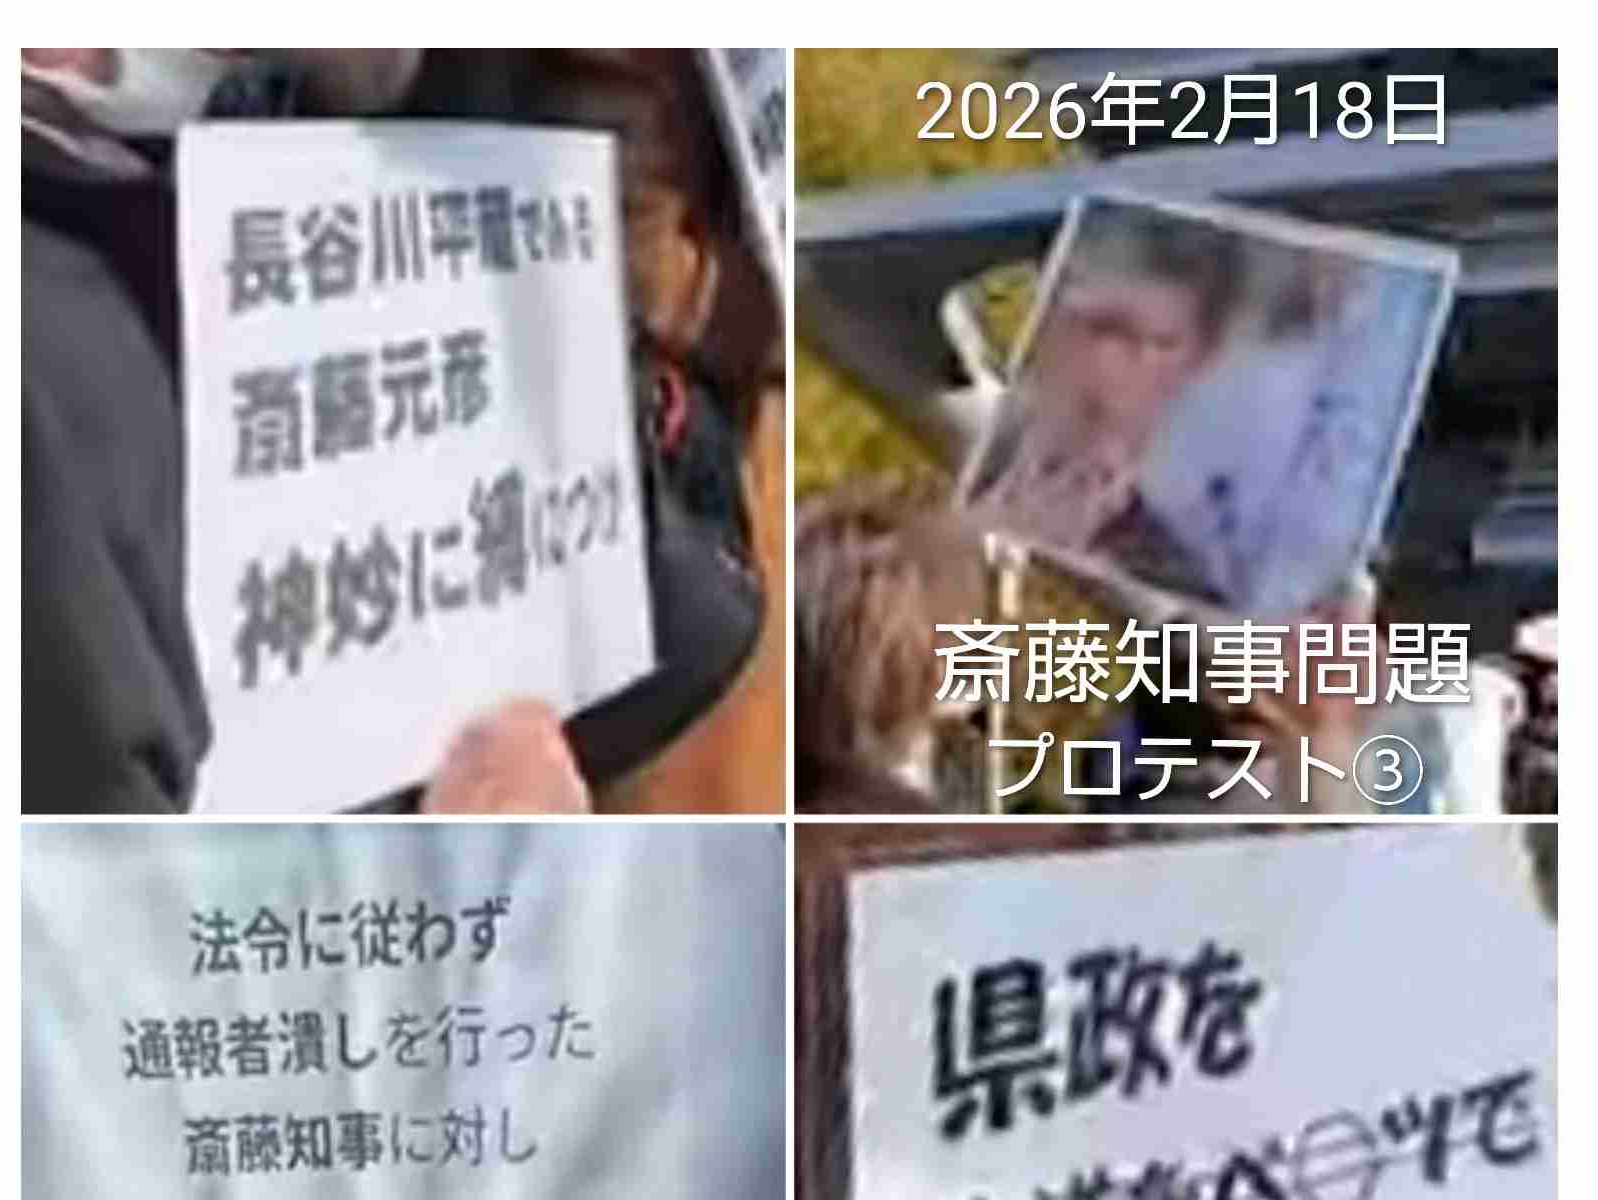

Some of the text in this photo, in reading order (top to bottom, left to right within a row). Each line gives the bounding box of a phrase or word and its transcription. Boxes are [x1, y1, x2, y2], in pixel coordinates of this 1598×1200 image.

[190, 896, 512, 976] 法令に従わず
[123, 1005, 598, 1080] 通報者潰しを行った
[933, 942, 1262, 1140] 県政を
[184, 1105, 538, 1176] 斎藤知事に対し
